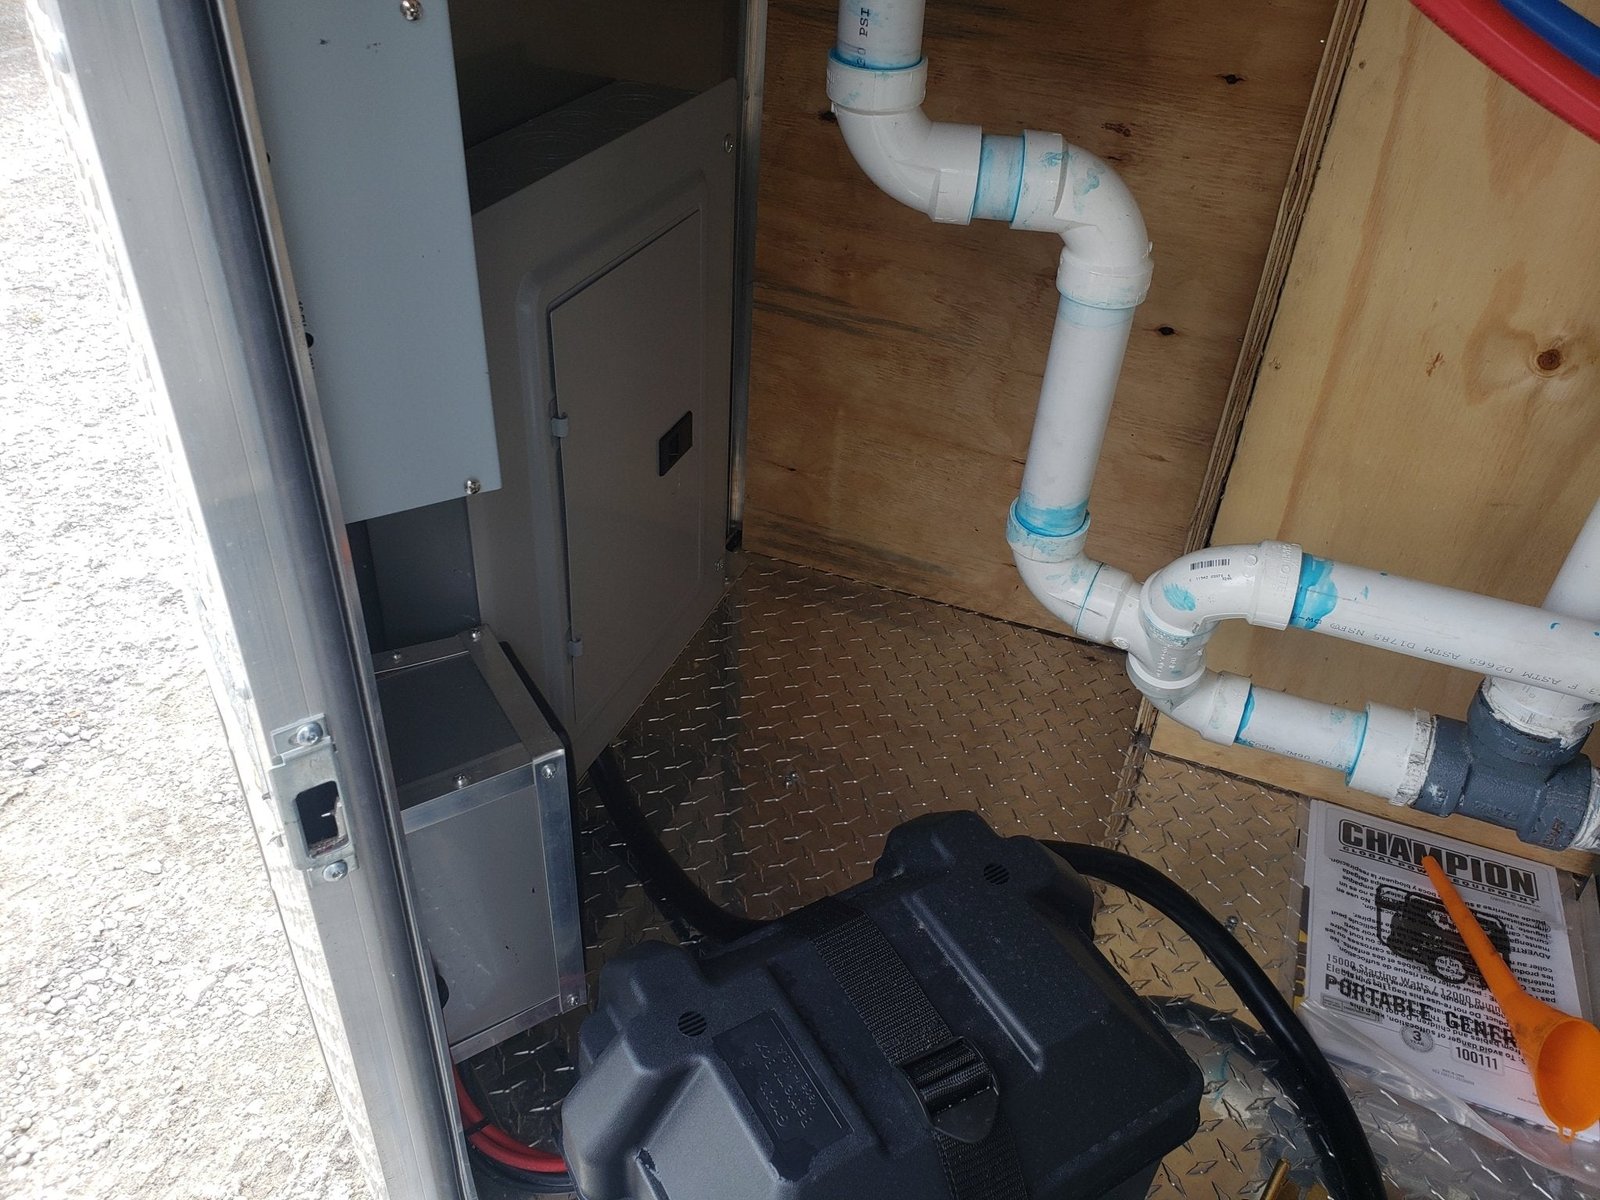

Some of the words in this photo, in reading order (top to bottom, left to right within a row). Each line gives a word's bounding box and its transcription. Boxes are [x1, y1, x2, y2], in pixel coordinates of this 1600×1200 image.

[859, 7, 870, 38] PSI
[1423, 645, 1461, 661] ASTM
[1468, 655, 1515, 675] D2665
[1521, 669, 1562, 686] ASTM
[1341, 821, 1534, 897] CHAMPION
[1328, 857, 1370, 877] respiración.
[1341, 846, 1393, 864] GLOBAL
[1399, 862, 1429, 874] POW
[1453, 878, 1539, 904] EQUIPMENT
[1342, 868, 1369, 882] delgada
[1342, 875, 1374, 890] empaque
[1378, 876, 1411, 889] bloquear
[1336, 886, 1345, 894] en
[1346, 891, 1359, 900] use
[1418, 888, 1436, 897] boca
[1330, 910, 1347, 919] peut
[1324, 927, 1336, 935] les
[1329, 922, 1348, 934] autre
[1329, 935, 1340, 943] Ne
[1337, 931, 1346, 939] ou
[1349, 931, 1364, 940] tout
[1347, 937, 1385, 954] carrosses
[1371, 953, 1386, 961] des
[1393, 966, 1419, 978] risque
[1541, 973, 1554, 981] les
[1327, 953, 1355, 970] 15000
[1401, 976, 1429, 990] Watts
[1440, 988, 1471, 1003] 12000
[1474, 997, 1501, 1012] Runn
[1420, 974, 1436, 984] tout
[1408, 992, 1425, 1001] this
[1426, 997, 1452, 1010] re-use
[1325, 973, 1432, 1022] PORTABLE
[1445, 1010, 1517, 1049] GENER
[1453, 1006, 1467, 1016] not
[1468, 1011, 1481, 1019] Do
[1483, 1014, 1509, 1028] oduct.
[1412, 1031, 1422, 1042] 3
[1452, 1030, 1469, 1038] and
[1448, 1036, 1478, 1050] danger
[1479, 1045, 1503, 1058] avoid
[1505, 1053, 1515, 1062] To
[1455, 1046, 1498, 1070] 100111
